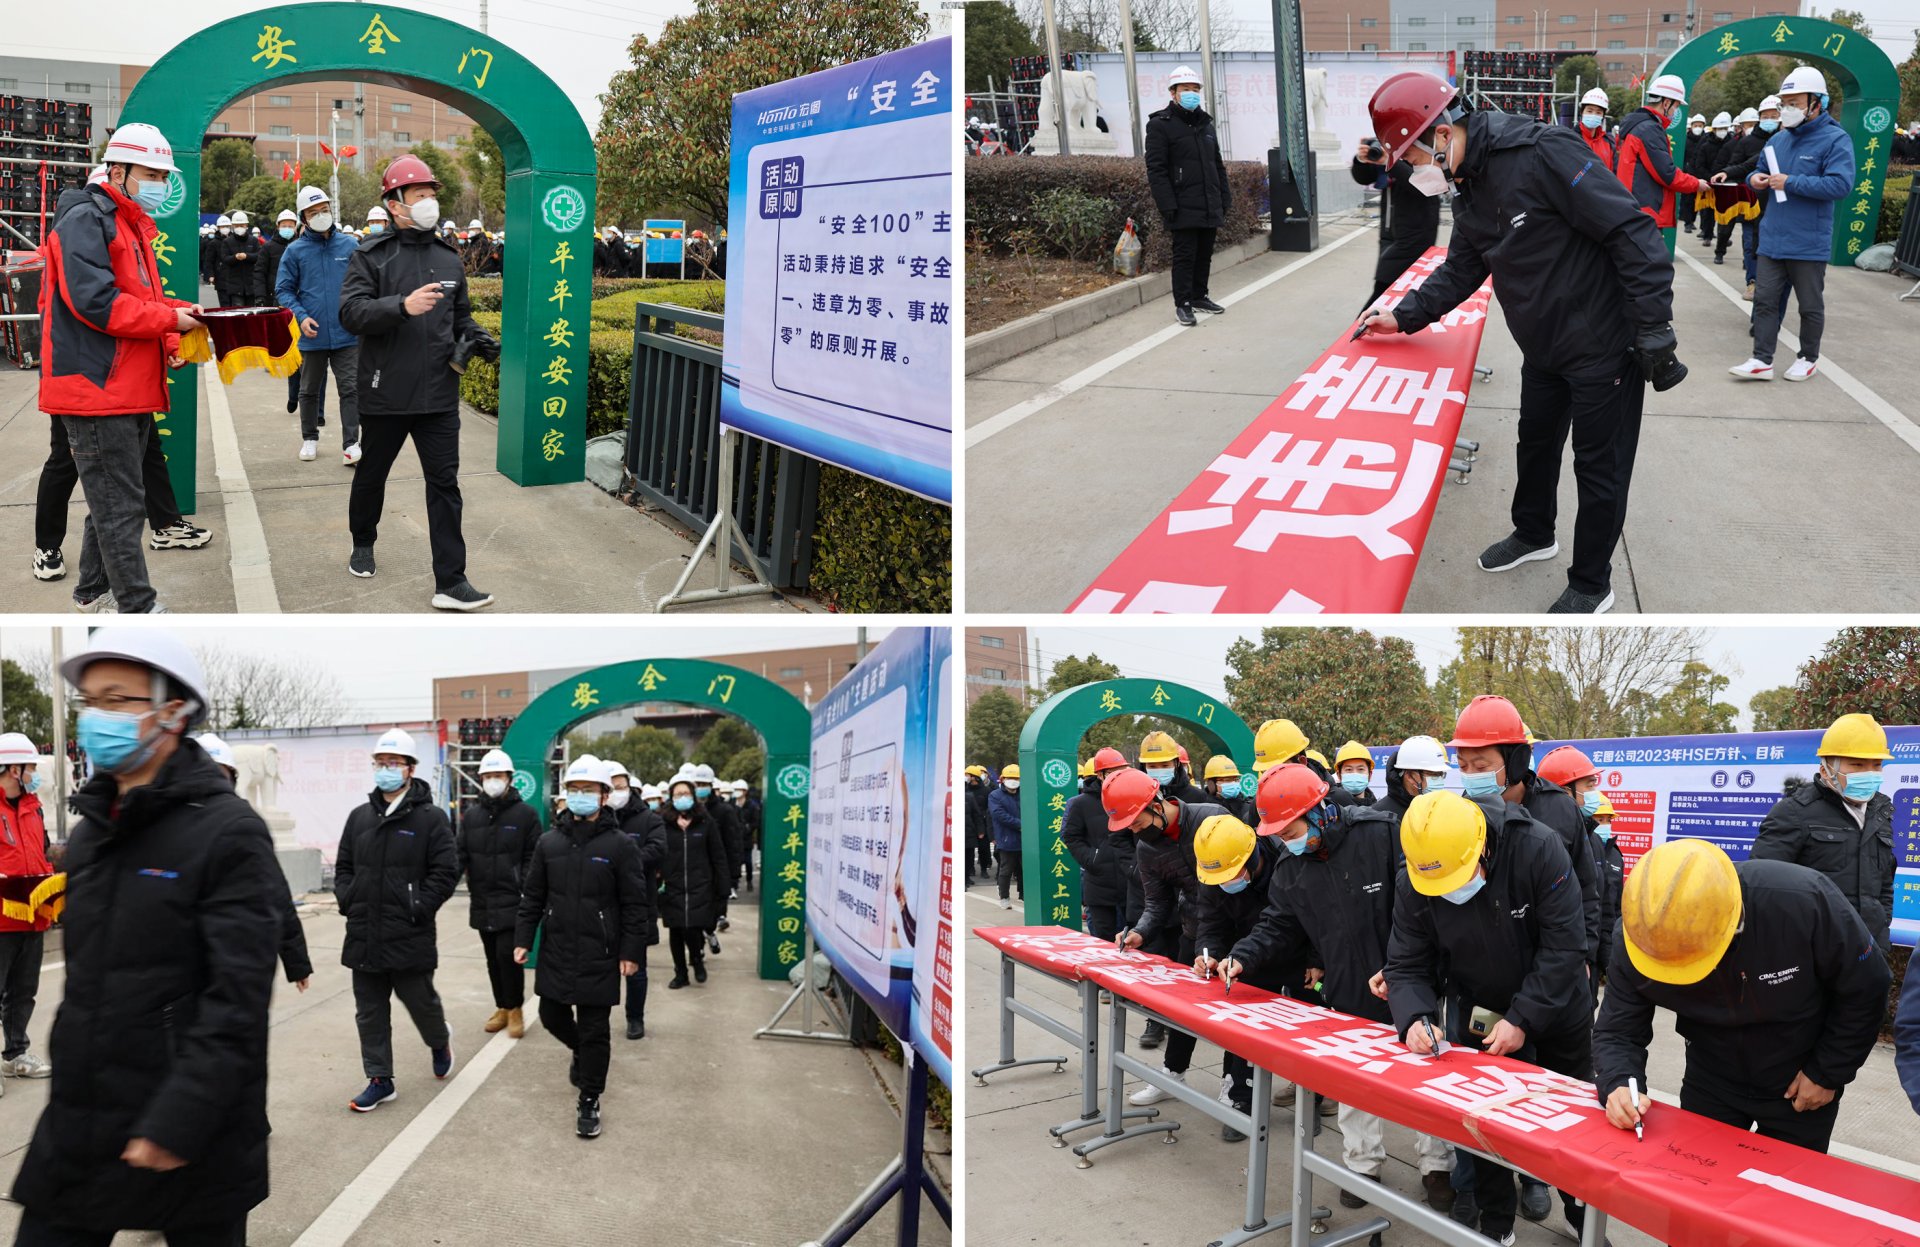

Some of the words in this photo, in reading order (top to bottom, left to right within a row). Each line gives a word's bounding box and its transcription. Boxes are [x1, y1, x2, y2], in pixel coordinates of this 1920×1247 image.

[252, 13, 494, 89] 安全门
[1717, 20, 1846, 57] 安全门
[766, 162, 799, 187] 活动
[764, 190, 798, 214] 原则
[1846, 137, 1881, 256] 平平安安回家
[541, 241, 574, 463] 平平安安回家
[571, 664, 736, 710] 安全门
[1100, 684, 1216, 725] 安全门
[1592, 745, 1786, 763] 宏图公司2023年HSE方针、目标
[1714, 773, 1751, 787] 目标
[1048, 793, 1071, 921] 安安全全上班
[777, 805, 806, 965] 平平安安回家
[1758, 972, 1778, 981] CIMC
[1777, 966, 1800, 977] ENRIC
